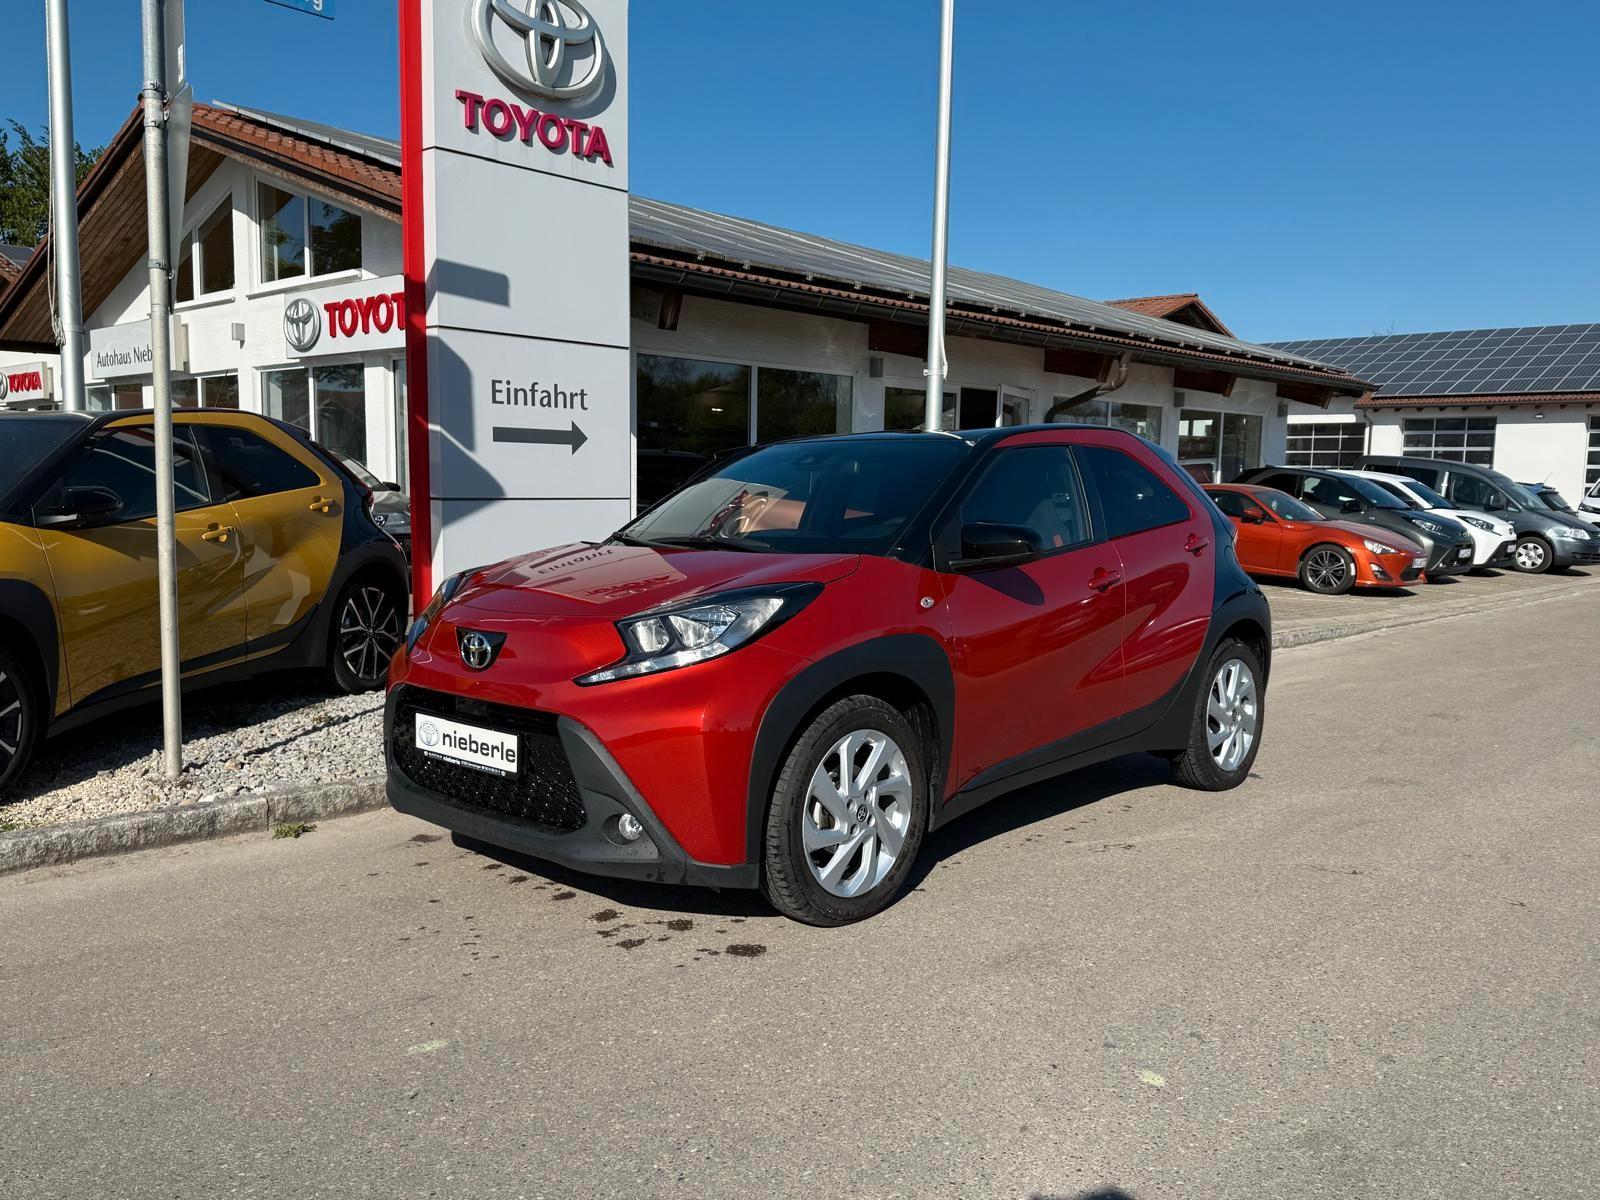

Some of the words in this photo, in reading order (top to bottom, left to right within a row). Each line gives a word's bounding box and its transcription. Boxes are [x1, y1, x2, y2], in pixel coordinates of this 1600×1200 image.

[455, 89, 612, 164] TOYOTA
[324, 292, 405, 338] TOYOT
[96, 348, 132, 368] Autohaus
[133, 344, 153, 363] Nieb
[7, 370, 42, 393] TOYOTA
[491, 379, 588, 411] Einfahrt
[442, 730, 517, 764] nieberle
